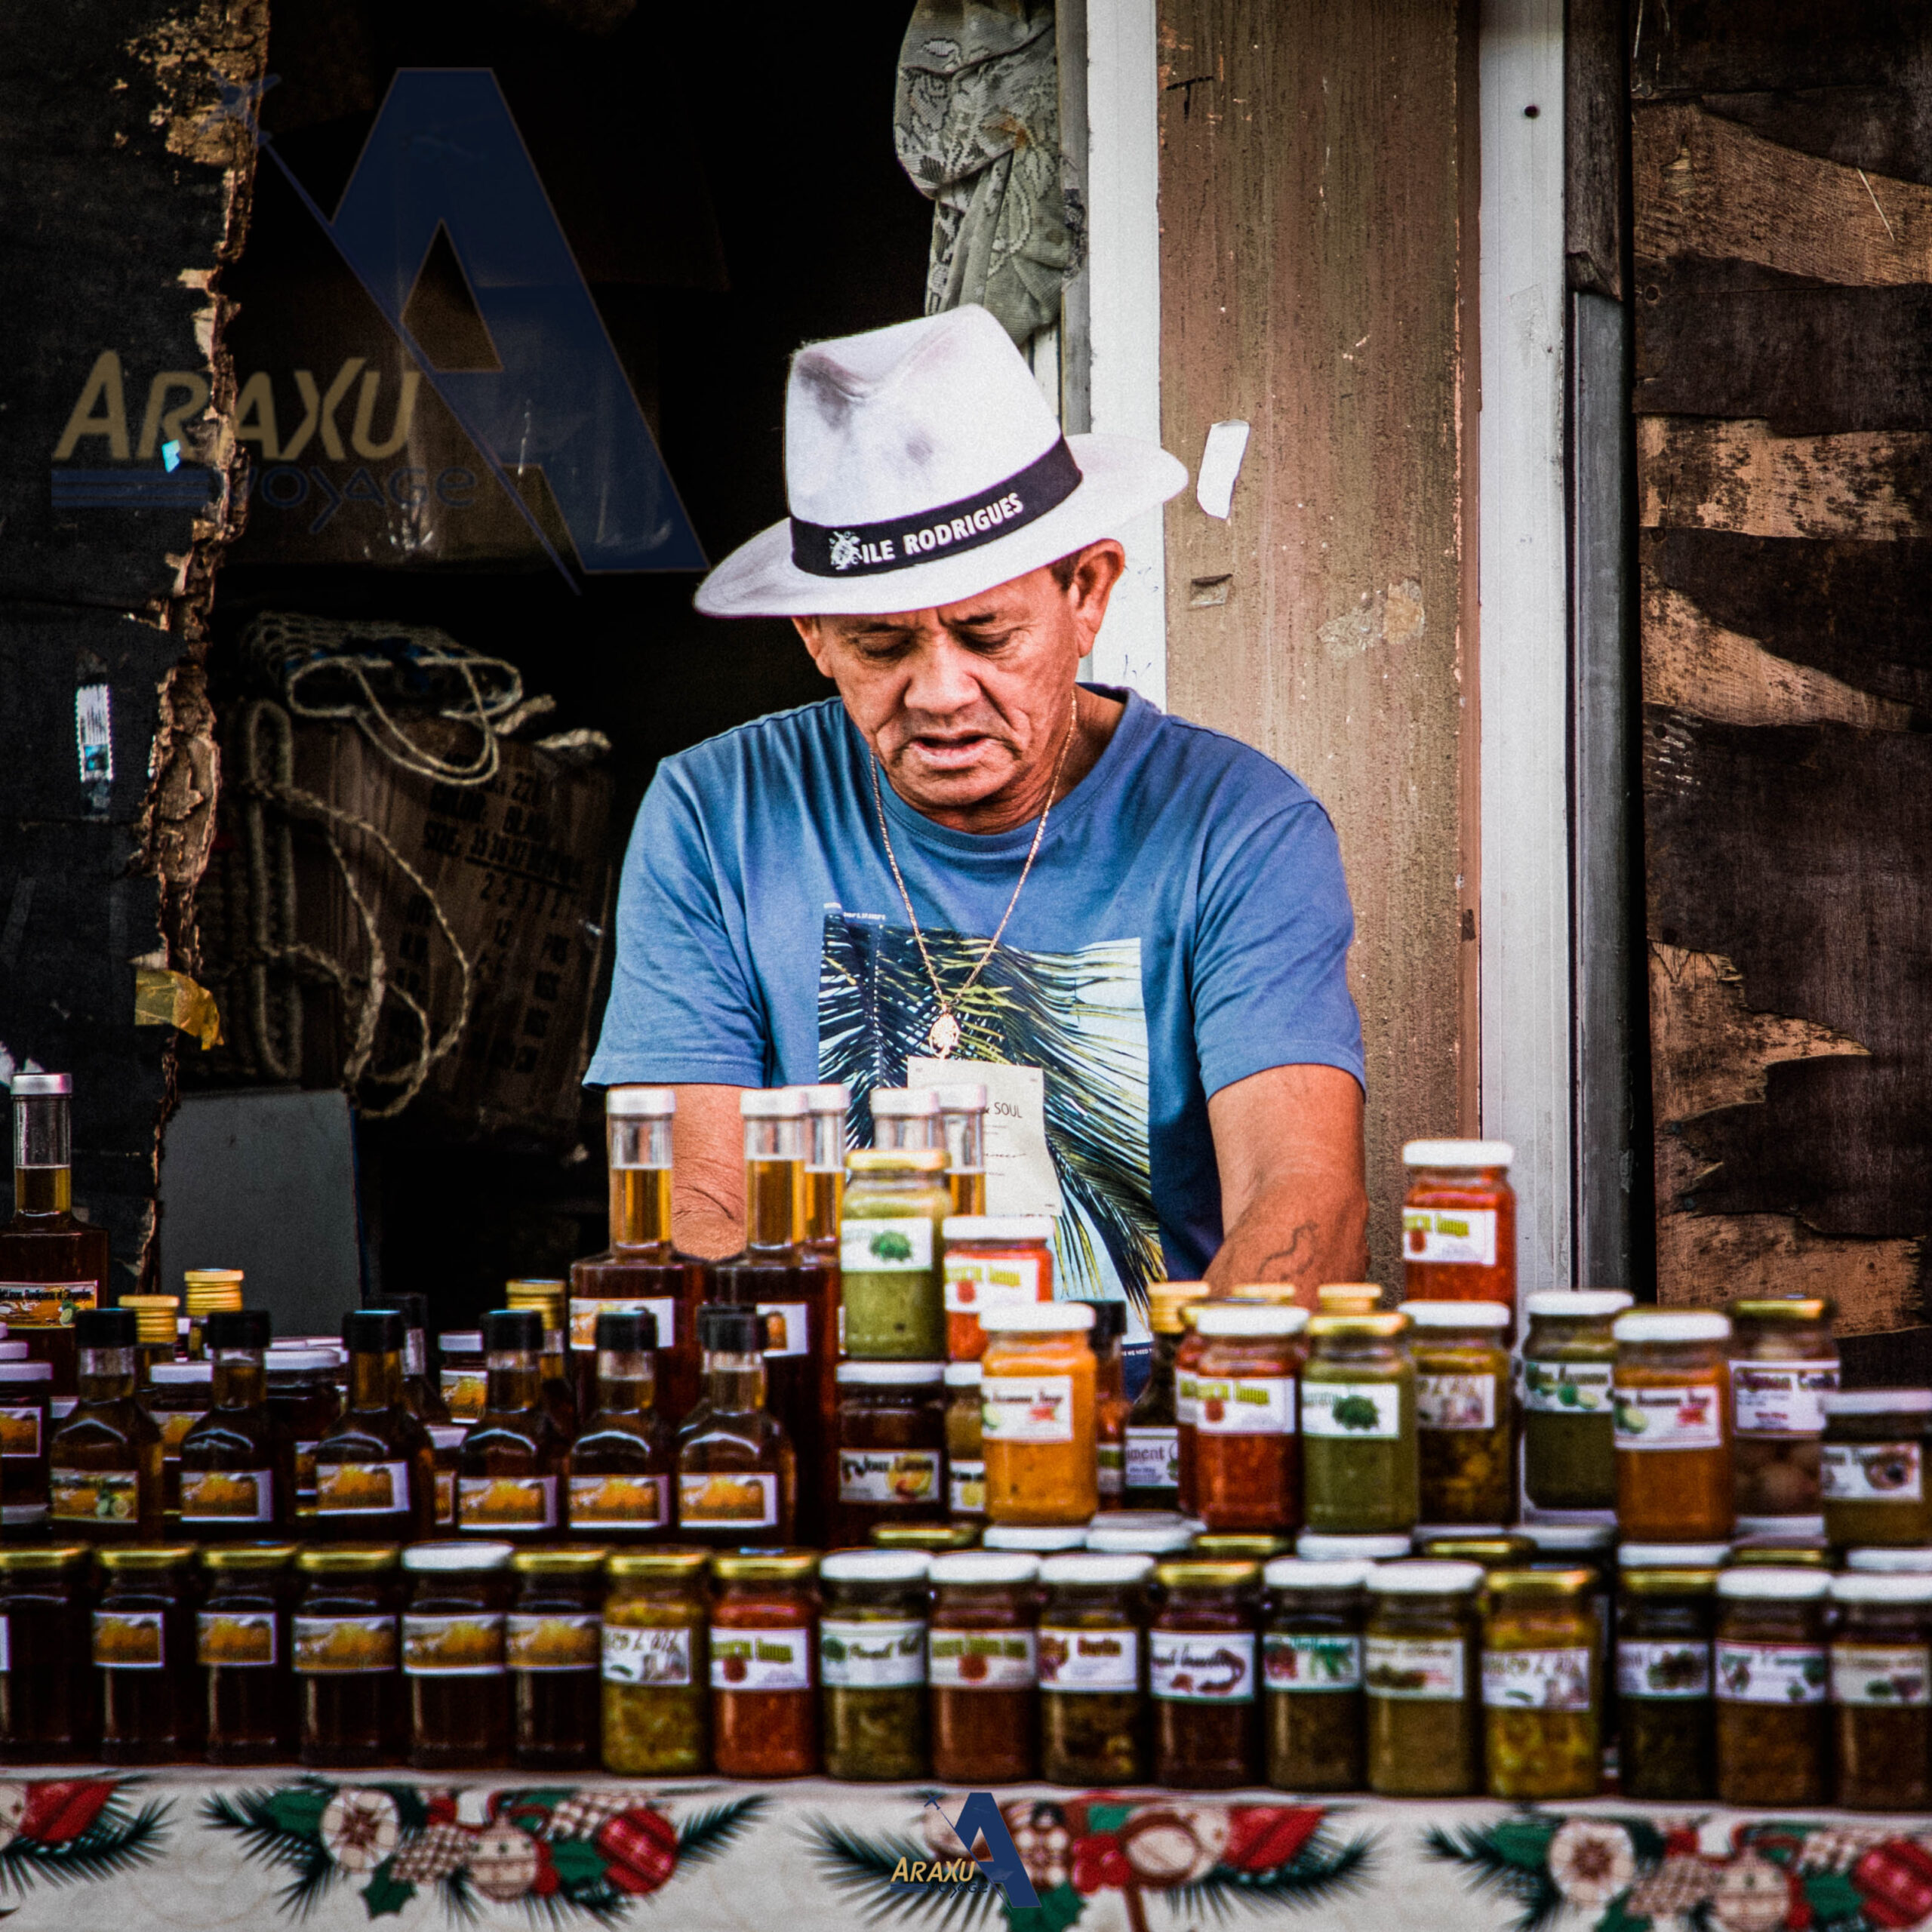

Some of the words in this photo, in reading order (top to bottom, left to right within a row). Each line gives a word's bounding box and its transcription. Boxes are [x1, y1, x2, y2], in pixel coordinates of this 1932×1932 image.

[861, 539, 896, 565] ILE
[903, 492, 1024, 555] RODRIGUES
[993, 1101, 1023, 1119] SOUL
